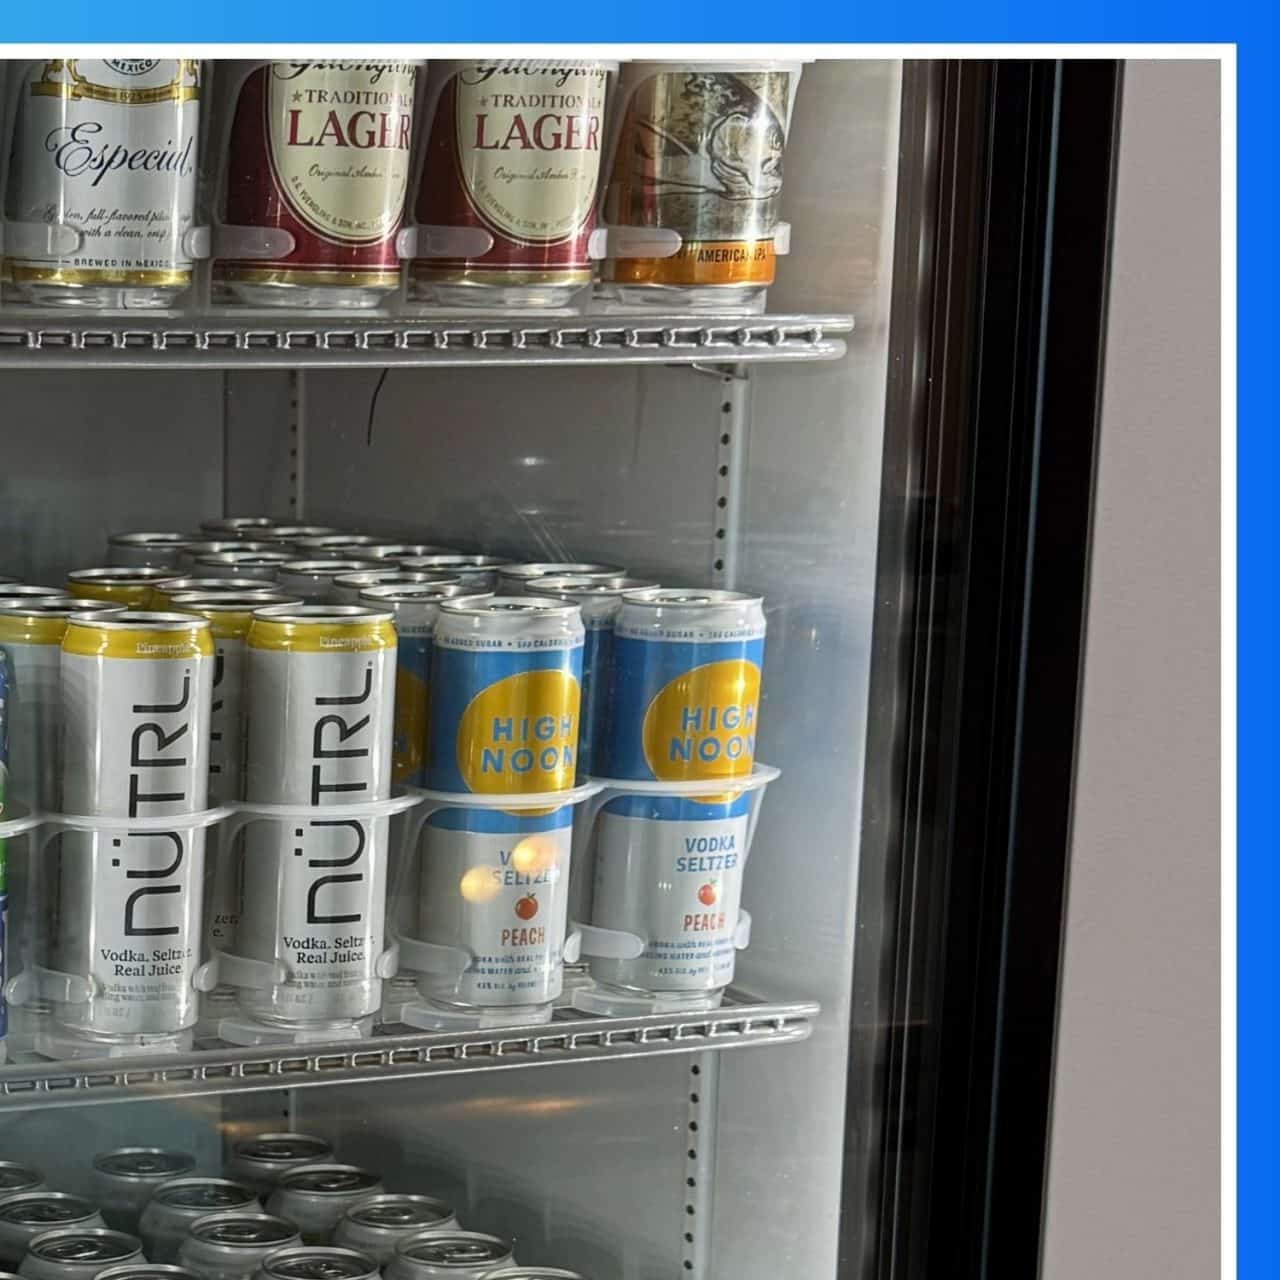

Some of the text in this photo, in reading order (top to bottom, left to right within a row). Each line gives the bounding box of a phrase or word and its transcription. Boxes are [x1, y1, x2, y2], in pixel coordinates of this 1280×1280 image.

[287, 109, 411, 150] LAGER
[472, 113, 600, 151] LAGER
[46, 121, 193, 187] Especial
[74, 258, 117, 268] BREWED
[121, 259, 132, 268] IN
[492, 713, 572, 743] HIGH
[681, 704, 756, 732] HIGH
[481, 744, 574, 774] NOON
[669, 735, 754, 763] NOON
[685, 834, 736, 853] VODKA
[676, 853, 738, 872] SELTZER
[683, 911, 726, 932] PEACH
[283, 935, 375, 950] Vodka. Seltz
[501, 926, 545, 947] PEACH
[101, 948, 149, 962] Vodka.
[296, 950, 365, 964] Real Juice.
[114, 963, 145, 977] Real
